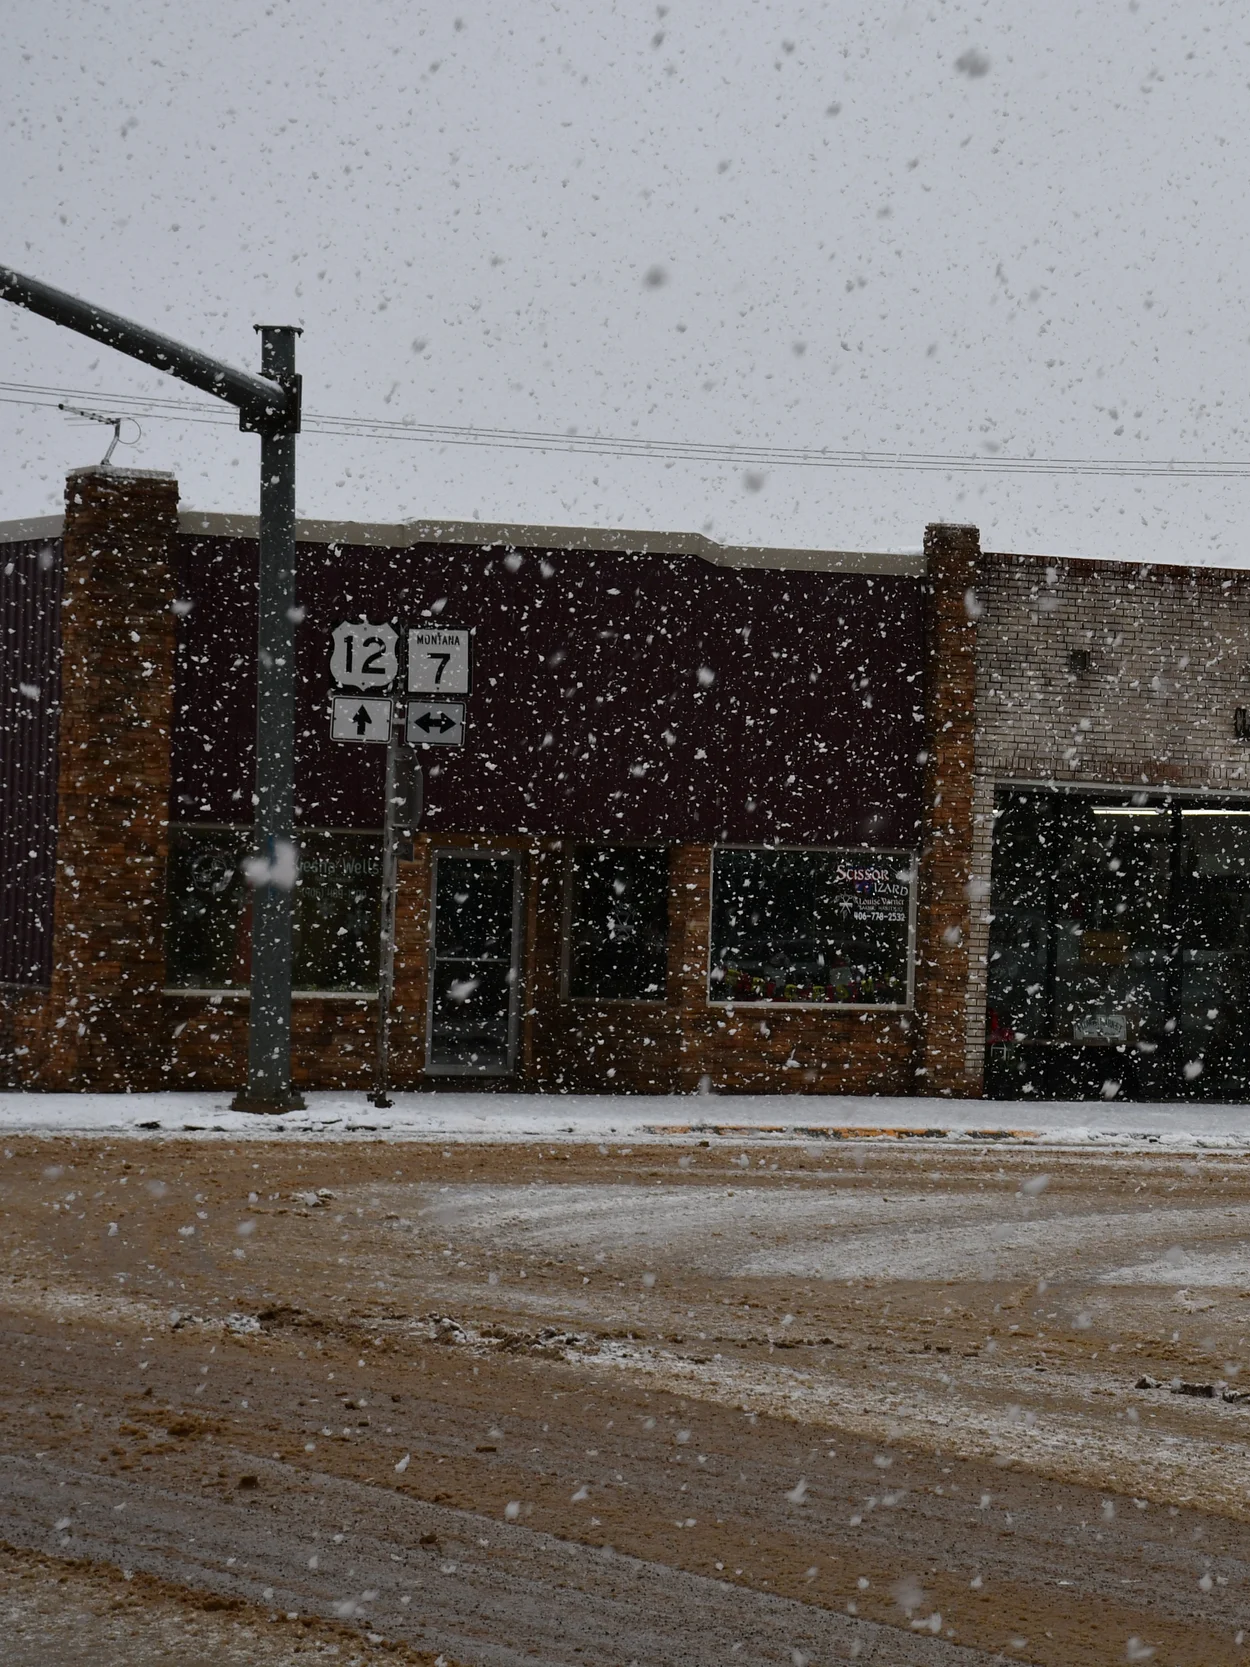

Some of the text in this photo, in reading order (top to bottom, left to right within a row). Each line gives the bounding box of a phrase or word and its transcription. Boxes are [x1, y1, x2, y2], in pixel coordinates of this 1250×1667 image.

[416, 633, 461, 646] MONTANA
[344, 635, 387, 675] 12
[427, 652, 451, 684] 7
[342, 857, 379, 875] Wells
[853, 911, 906, 922] 406-778-2532
